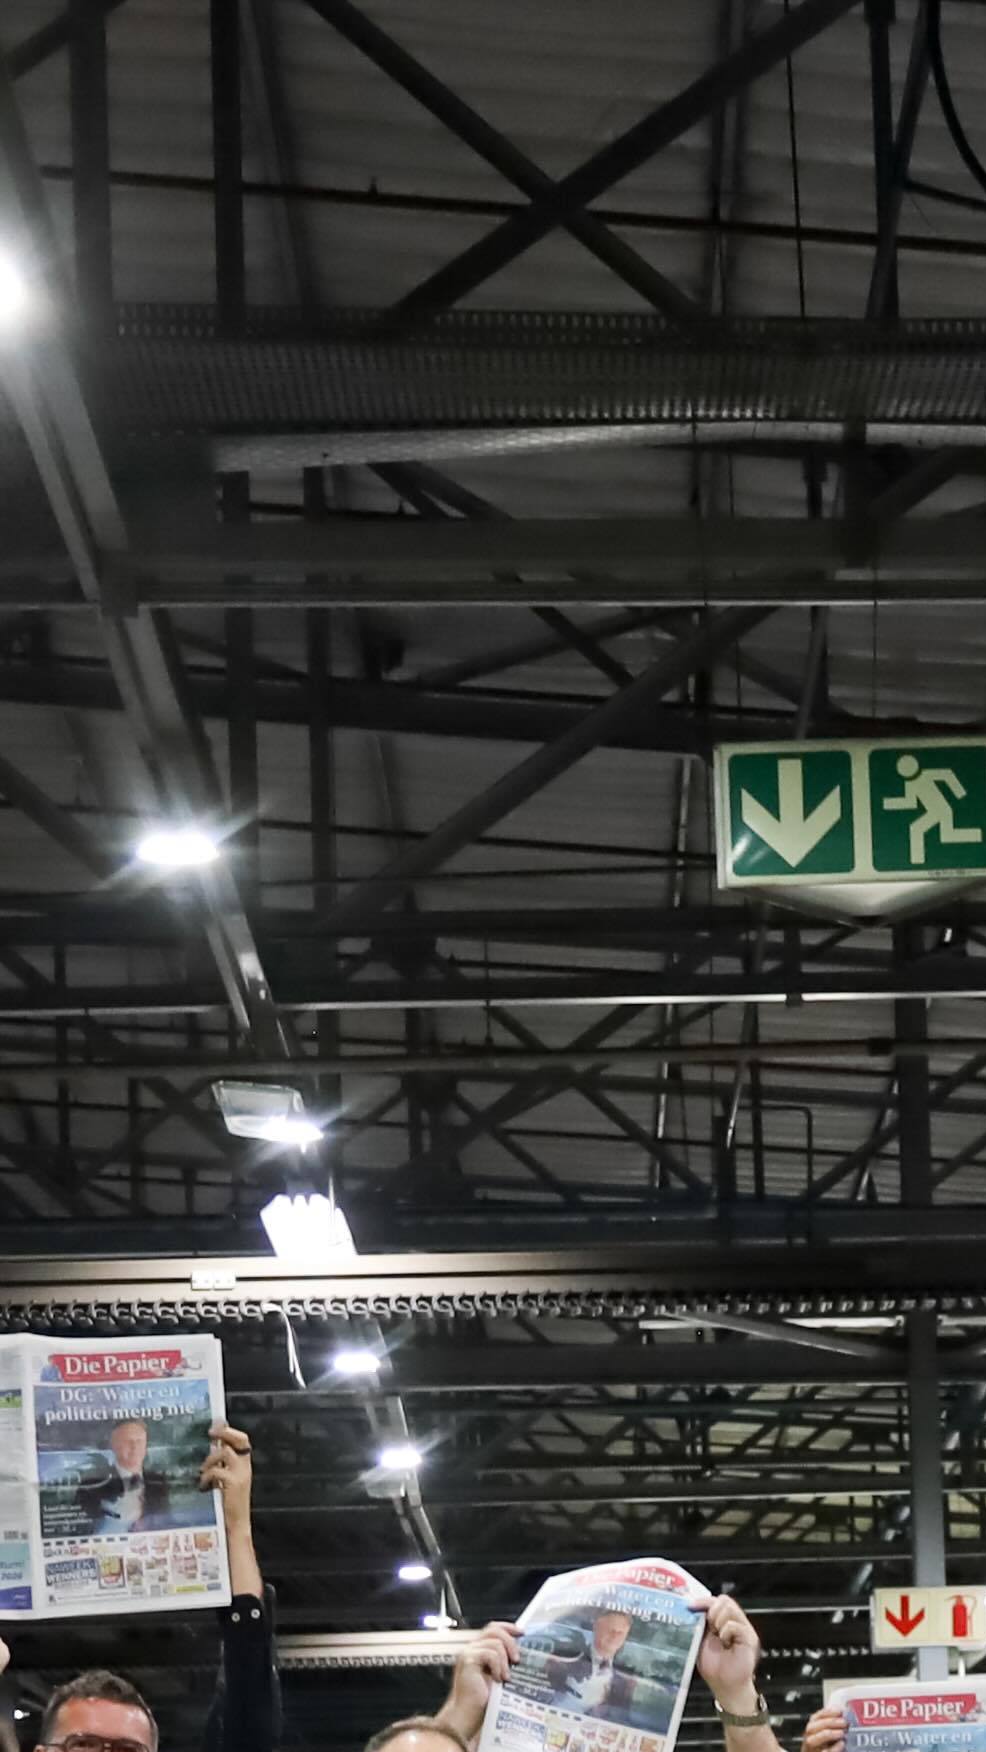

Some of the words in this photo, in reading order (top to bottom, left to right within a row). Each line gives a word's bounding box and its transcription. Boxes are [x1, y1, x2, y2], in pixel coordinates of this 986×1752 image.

[64, 1356, 99, 1375] Die
[103, 1353, 170, 1377] Papier
[159, 1386, 180, 1399] en
[45, 1406, 109, 1425] politici
[113, 1405, 165, 1421] meng
[605, 1601, 653, 1622] meng
[863, 1700, 898, 1719] Die
[901, 1697, 965, 1721] Papier
[951, 1731, 972, 1744] en
